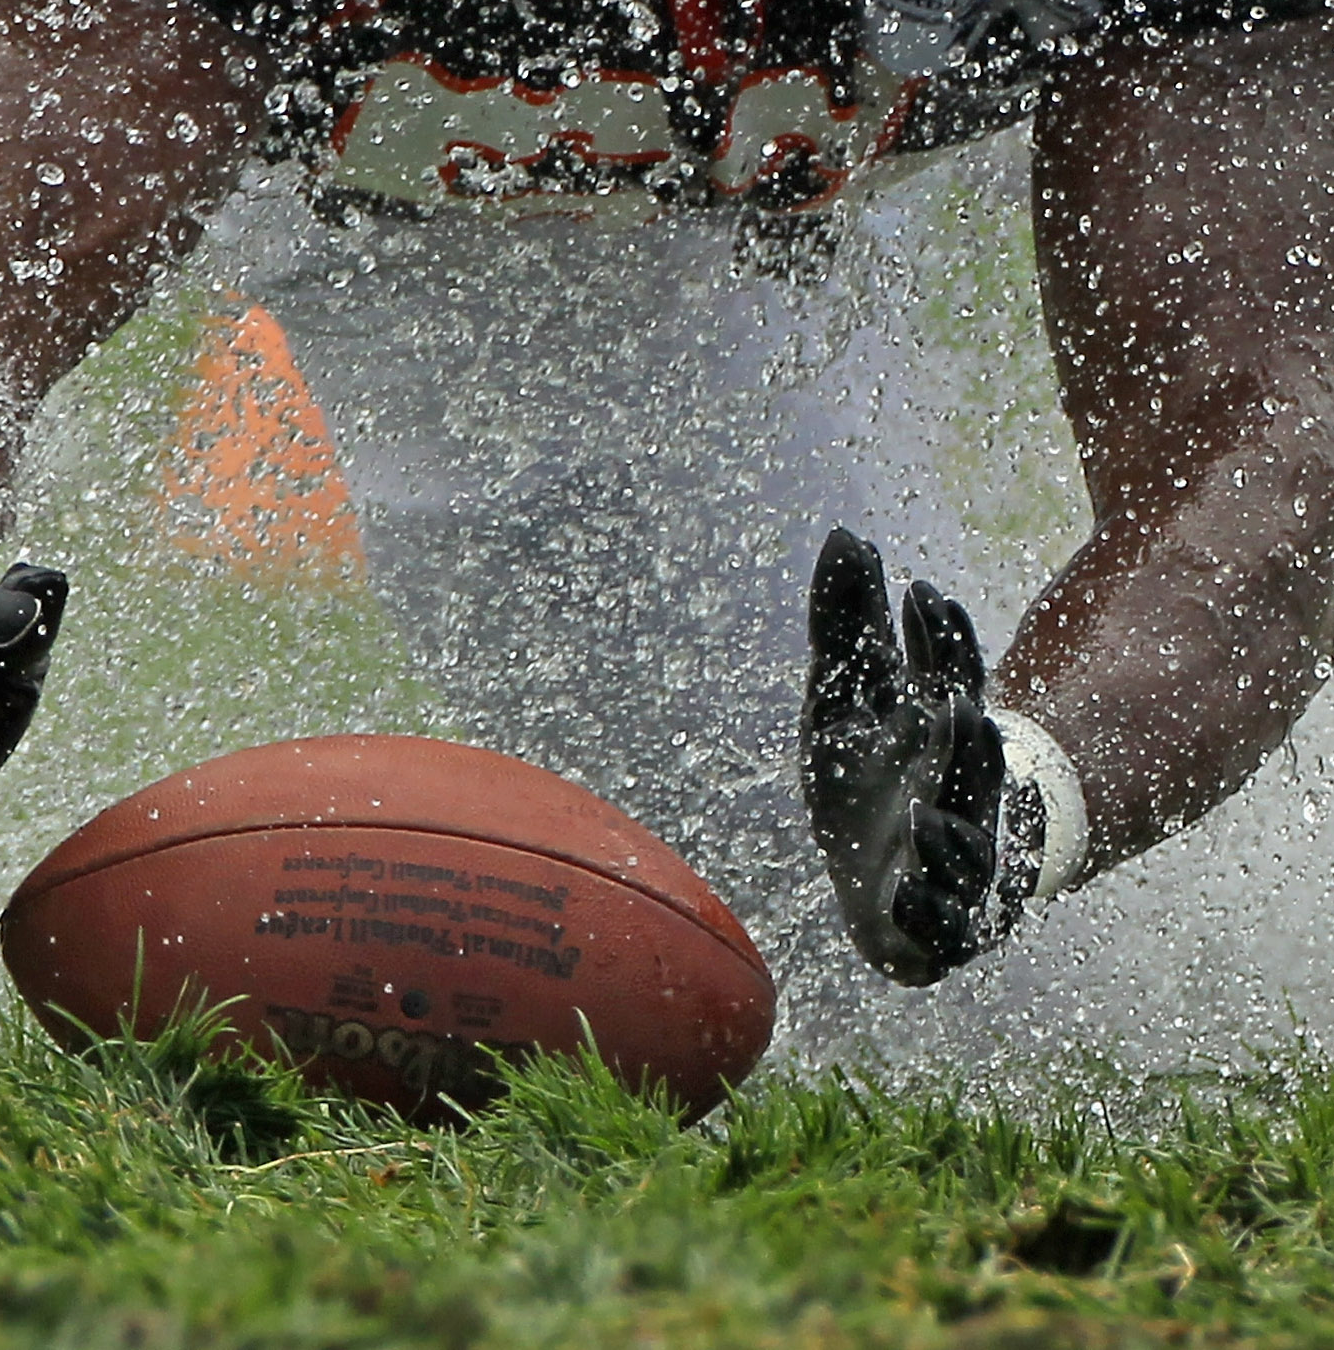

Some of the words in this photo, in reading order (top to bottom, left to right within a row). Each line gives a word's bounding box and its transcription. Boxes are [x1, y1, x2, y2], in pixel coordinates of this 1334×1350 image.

[255, 912, 342, 942] League
[351, 920, 456, 956] Football
[462, 934, 580, 980] National
